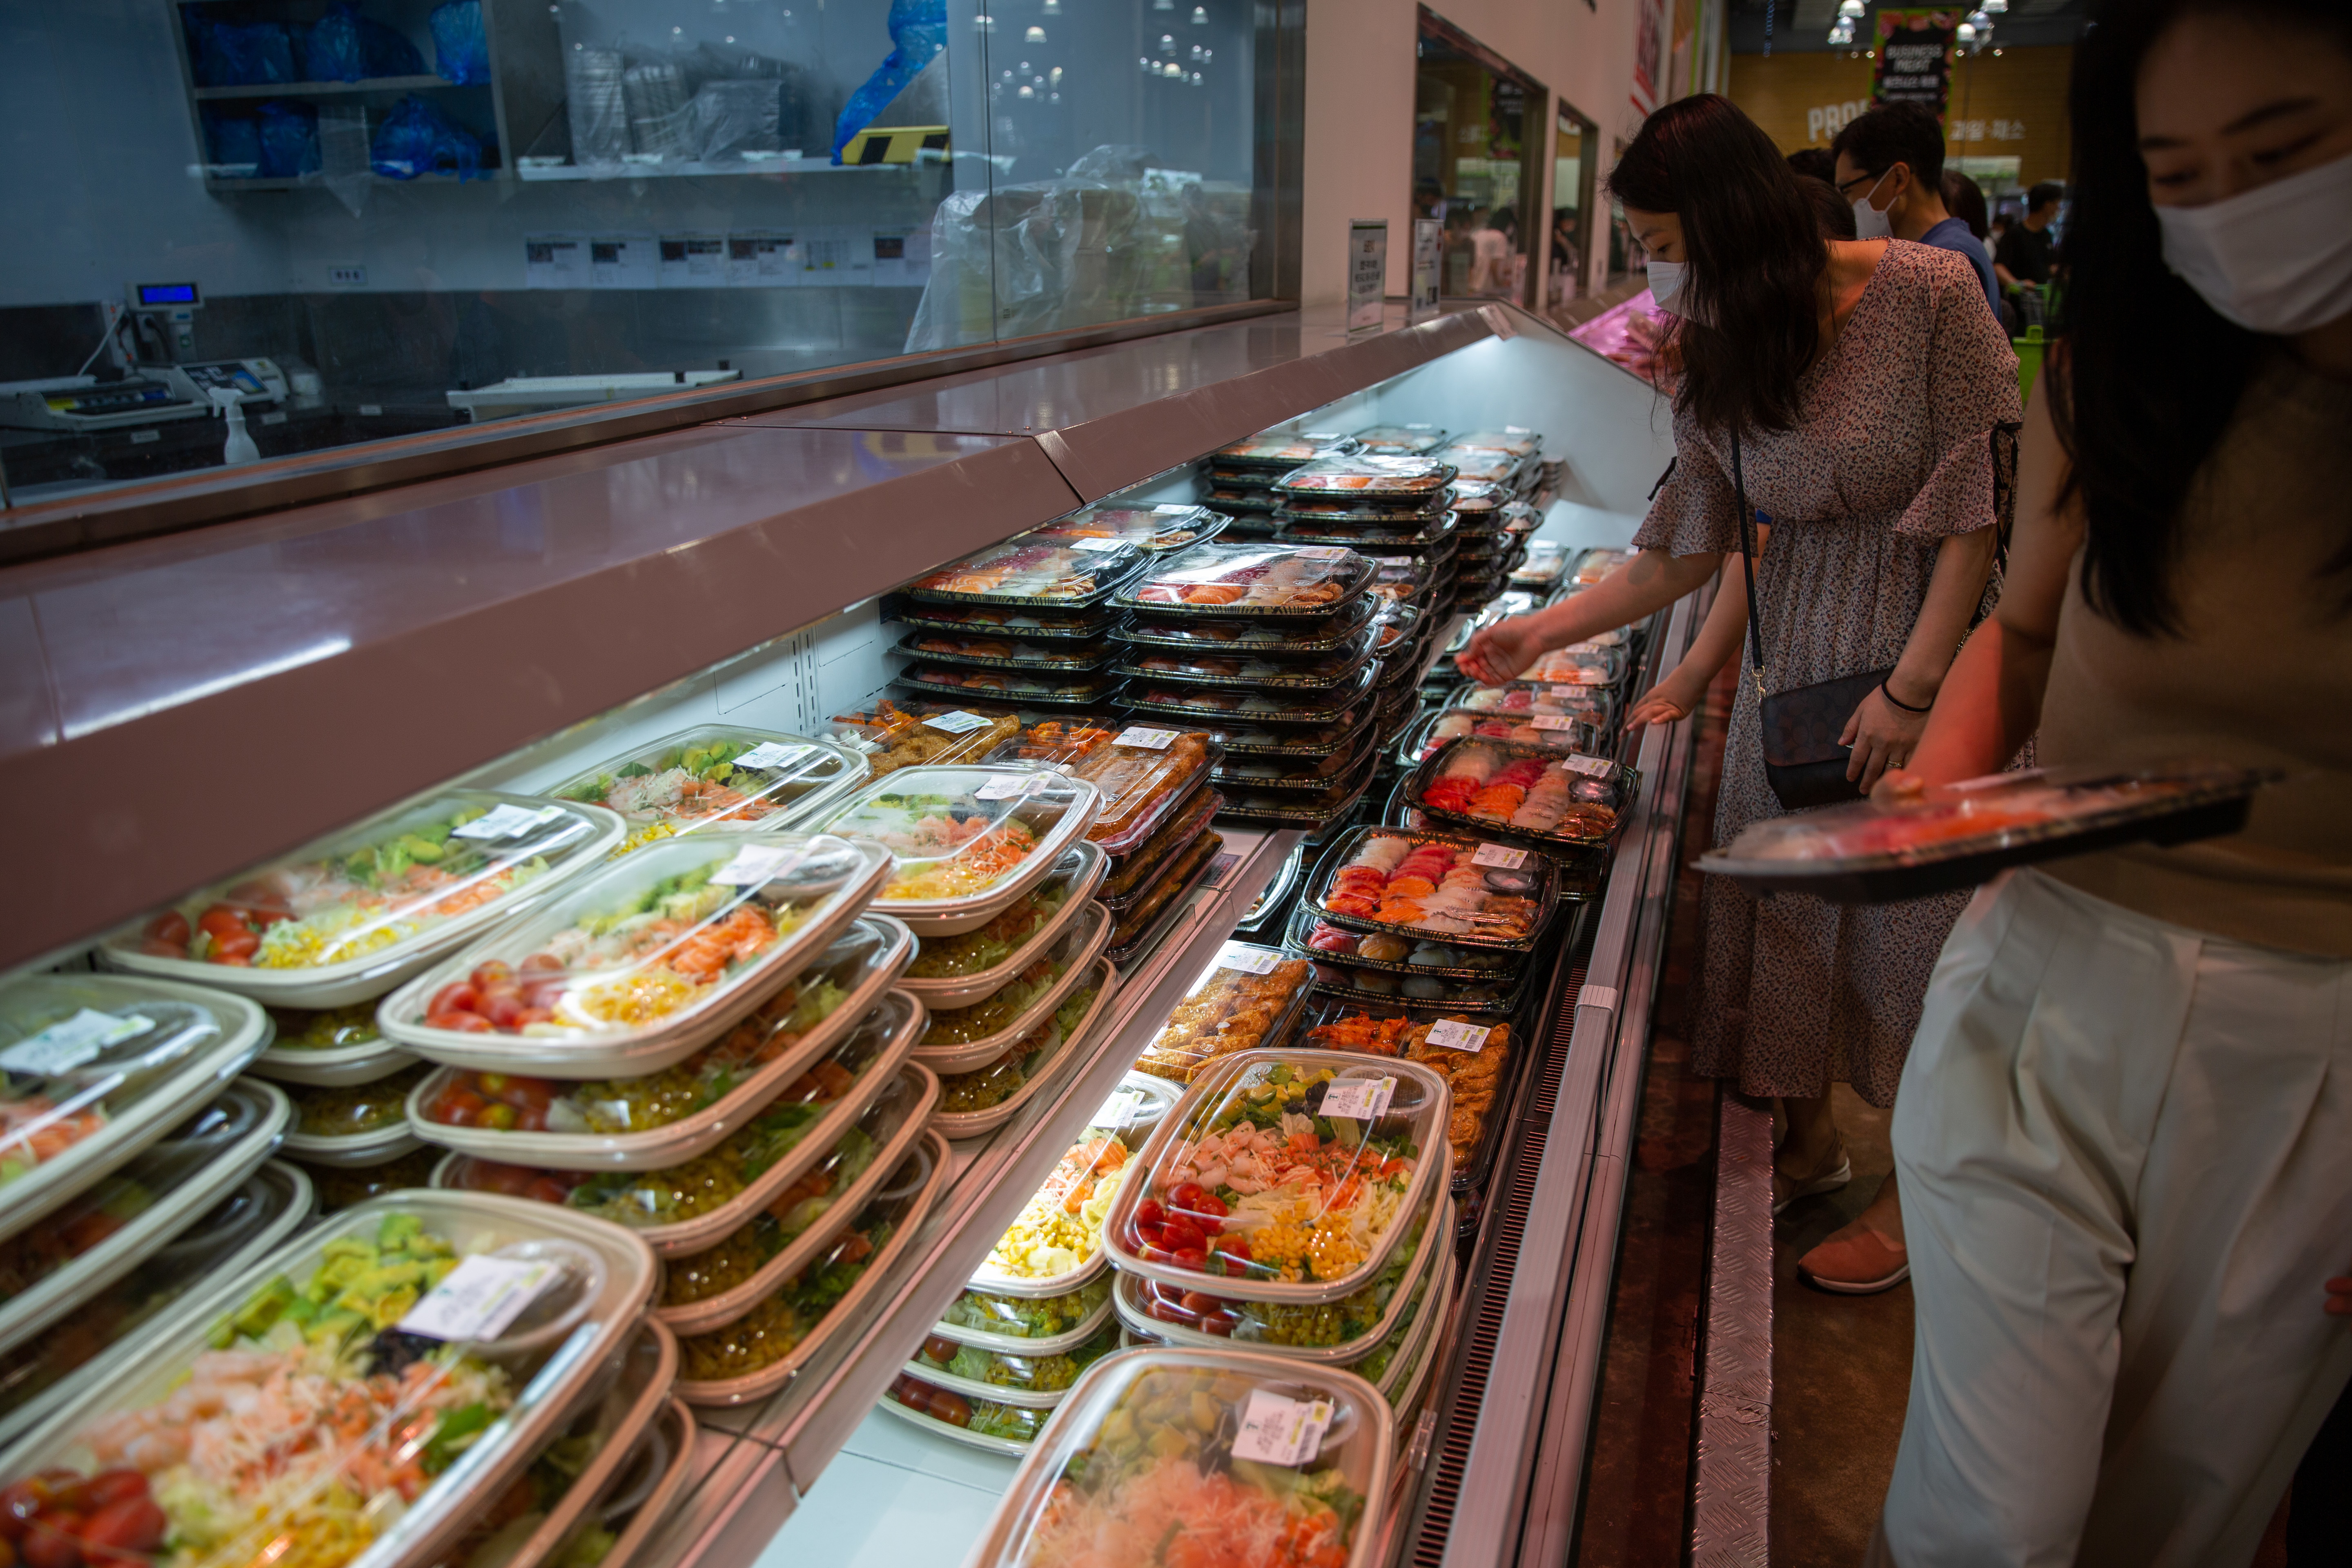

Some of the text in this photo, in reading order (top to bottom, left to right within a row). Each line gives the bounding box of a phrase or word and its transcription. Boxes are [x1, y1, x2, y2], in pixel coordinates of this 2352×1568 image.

[1885, 44, 1944, 59] BUSINESS
[1893, 59, 1933, 72] MEAT
[1808, 99, 1869, 143] PRO
